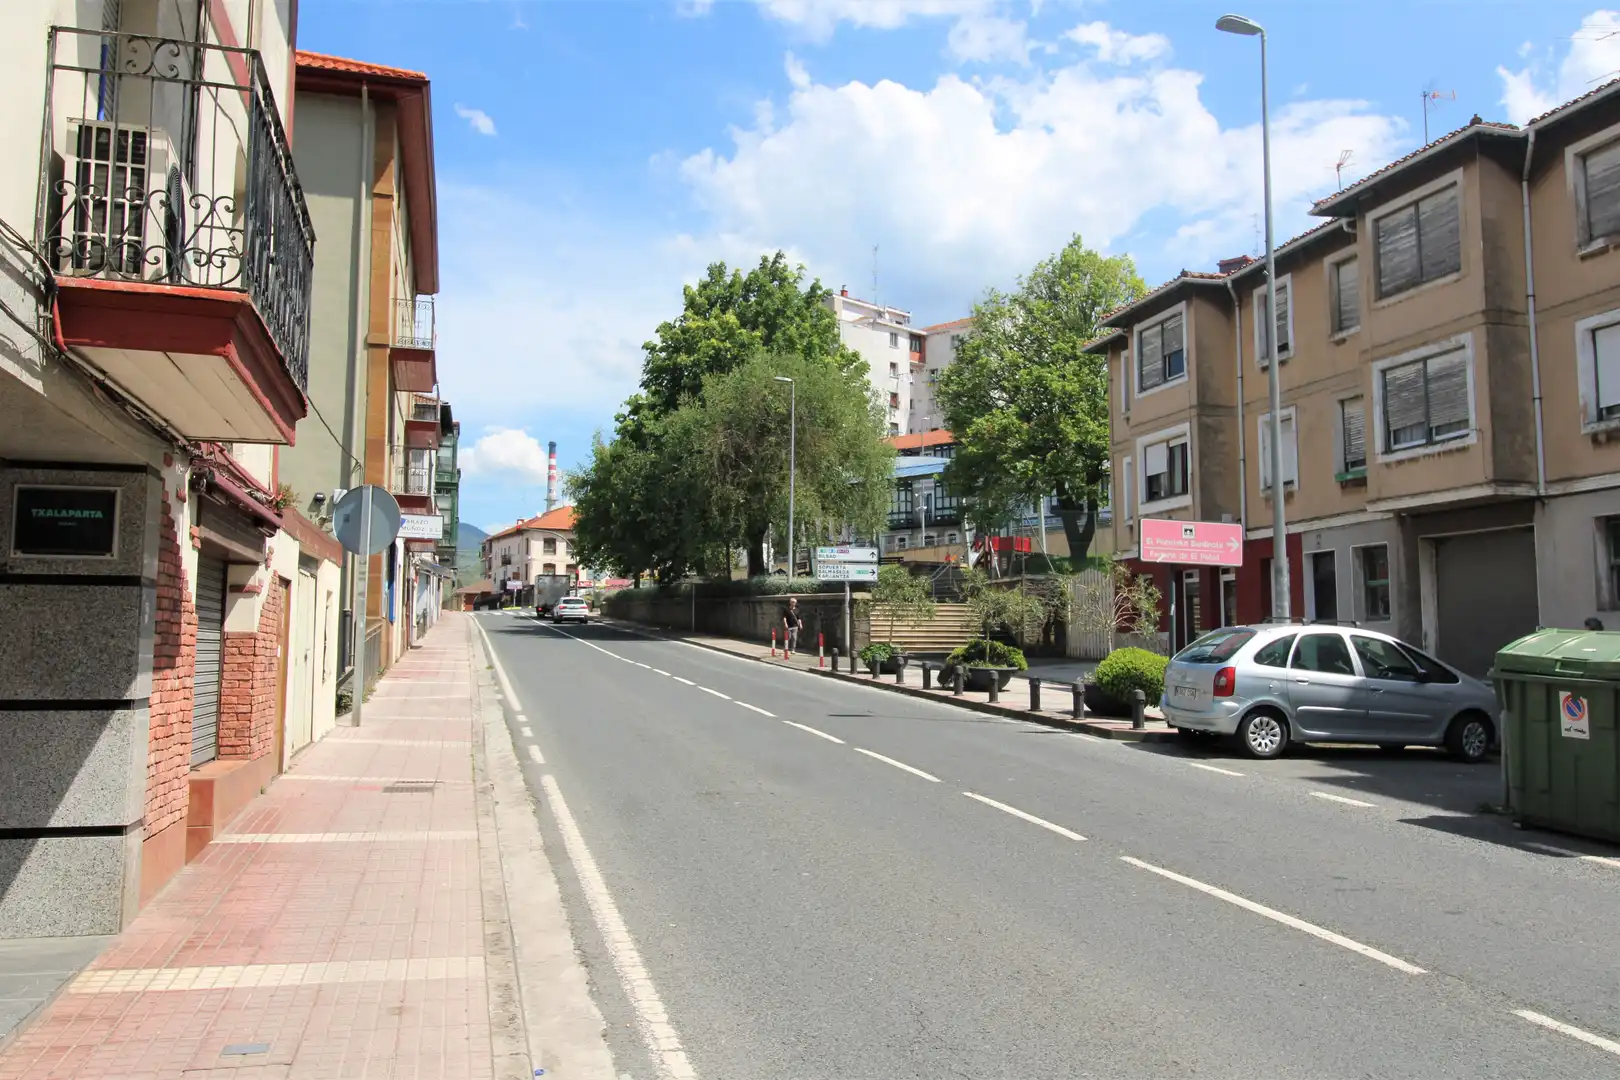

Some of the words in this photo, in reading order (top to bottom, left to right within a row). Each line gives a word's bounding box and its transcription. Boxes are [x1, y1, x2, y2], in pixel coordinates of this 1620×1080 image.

[31, 508, 103, 518] TXALAPARTA
[1145, 537, 1153, 545] El
[1190, 552, 1198, 560] El
